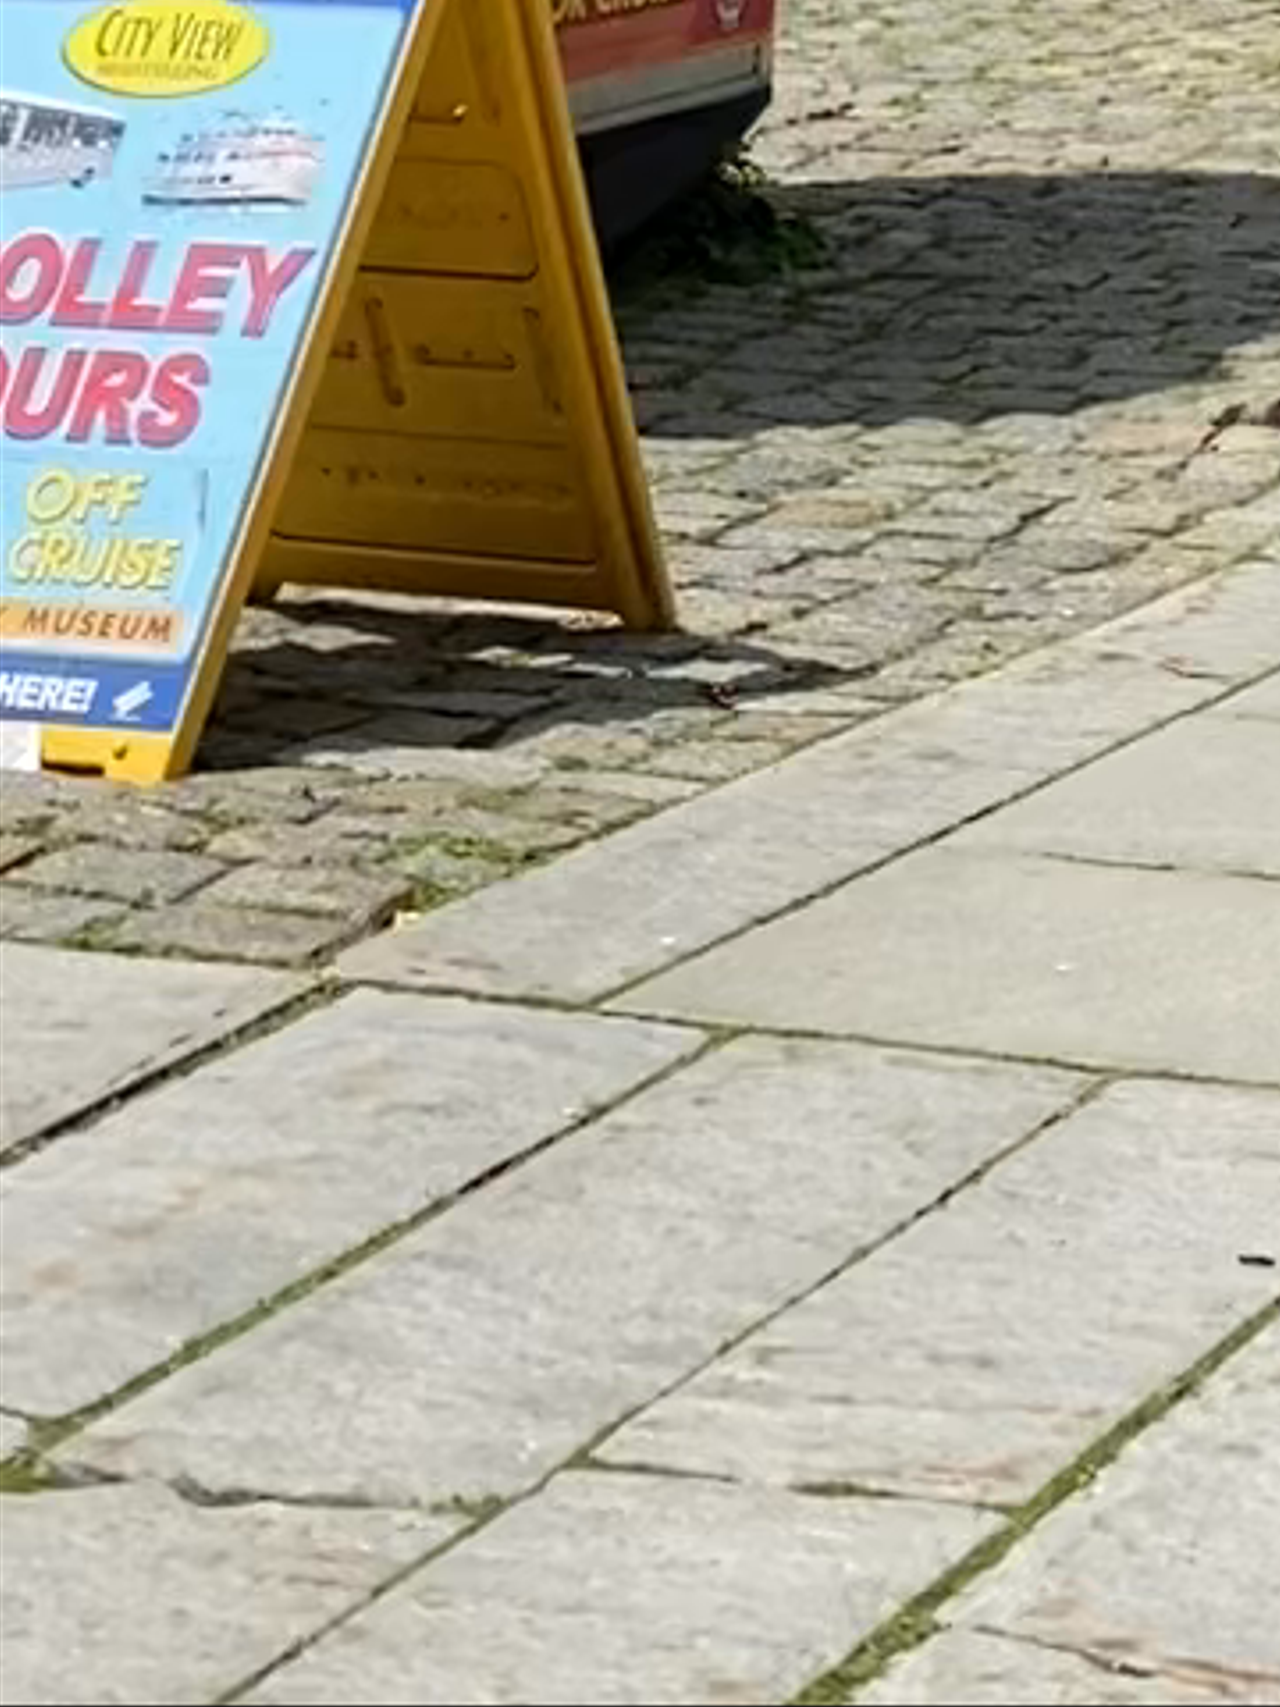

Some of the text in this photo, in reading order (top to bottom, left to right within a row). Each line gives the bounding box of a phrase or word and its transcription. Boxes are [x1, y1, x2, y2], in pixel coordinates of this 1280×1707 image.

[0, 231, 318, 340] OLLEY
[27, 468, 149, 526] OFF
[8, 530, 183, 592] CRUISE
[22, 608, 174, 643] MUSEUM
